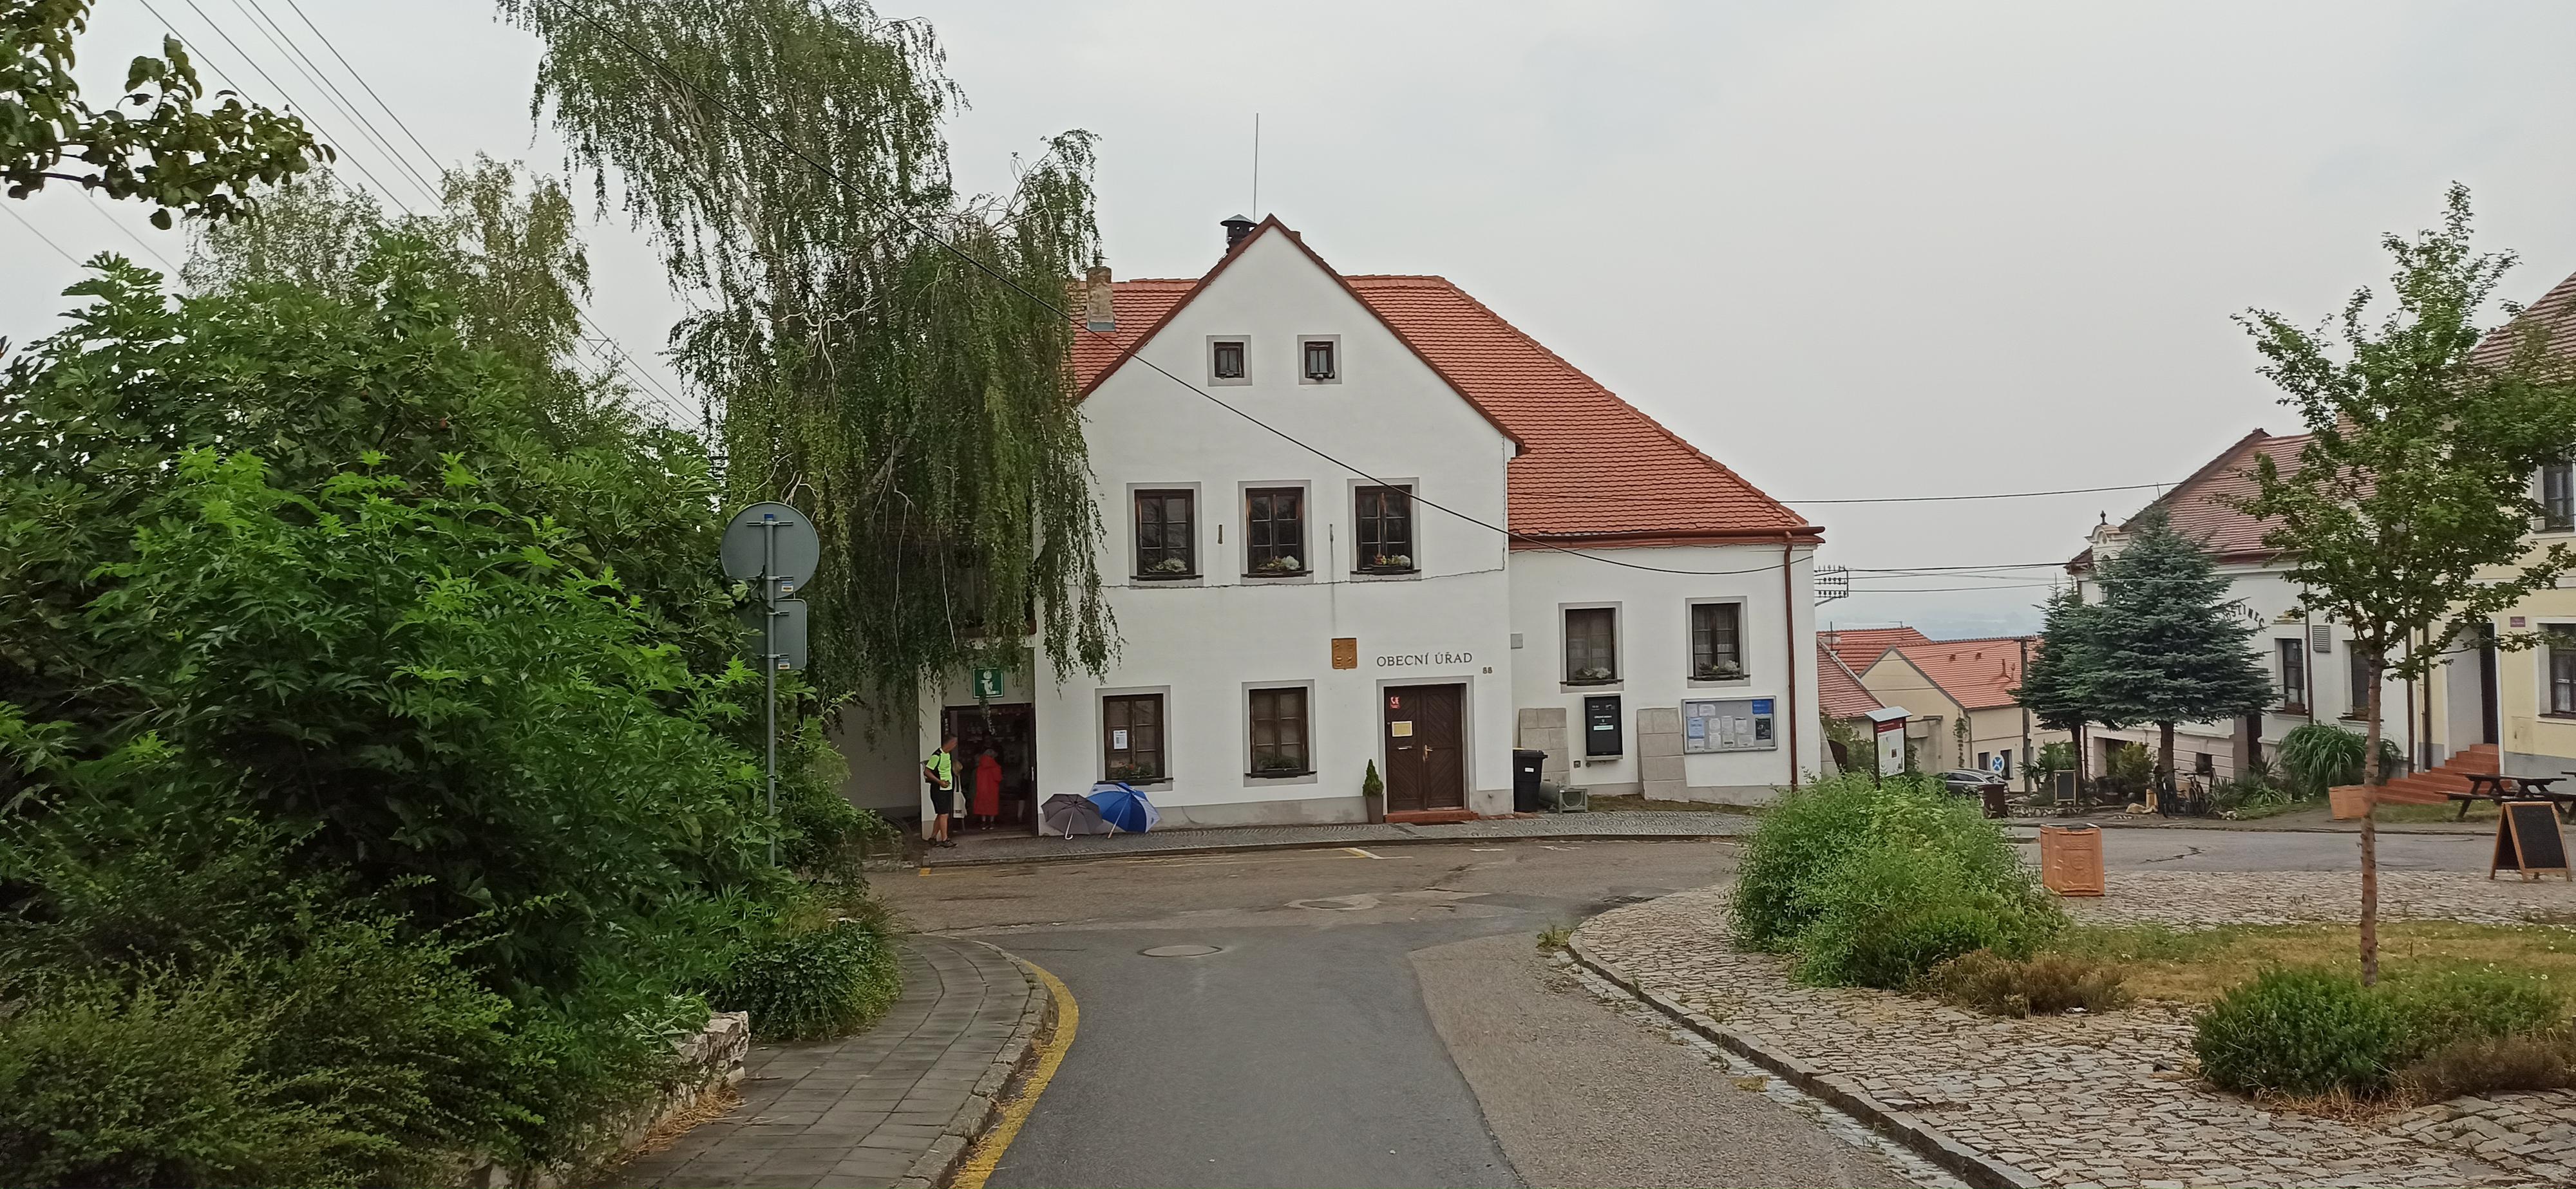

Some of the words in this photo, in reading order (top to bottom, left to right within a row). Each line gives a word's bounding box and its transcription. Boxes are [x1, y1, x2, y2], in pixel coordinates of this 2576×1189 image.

[2223, 603, 2265, 628] OSTINEC
[1376, 652, 1429, 667] OBECNÍ
[1435, 651, 1472, 664] ÚŘAD
